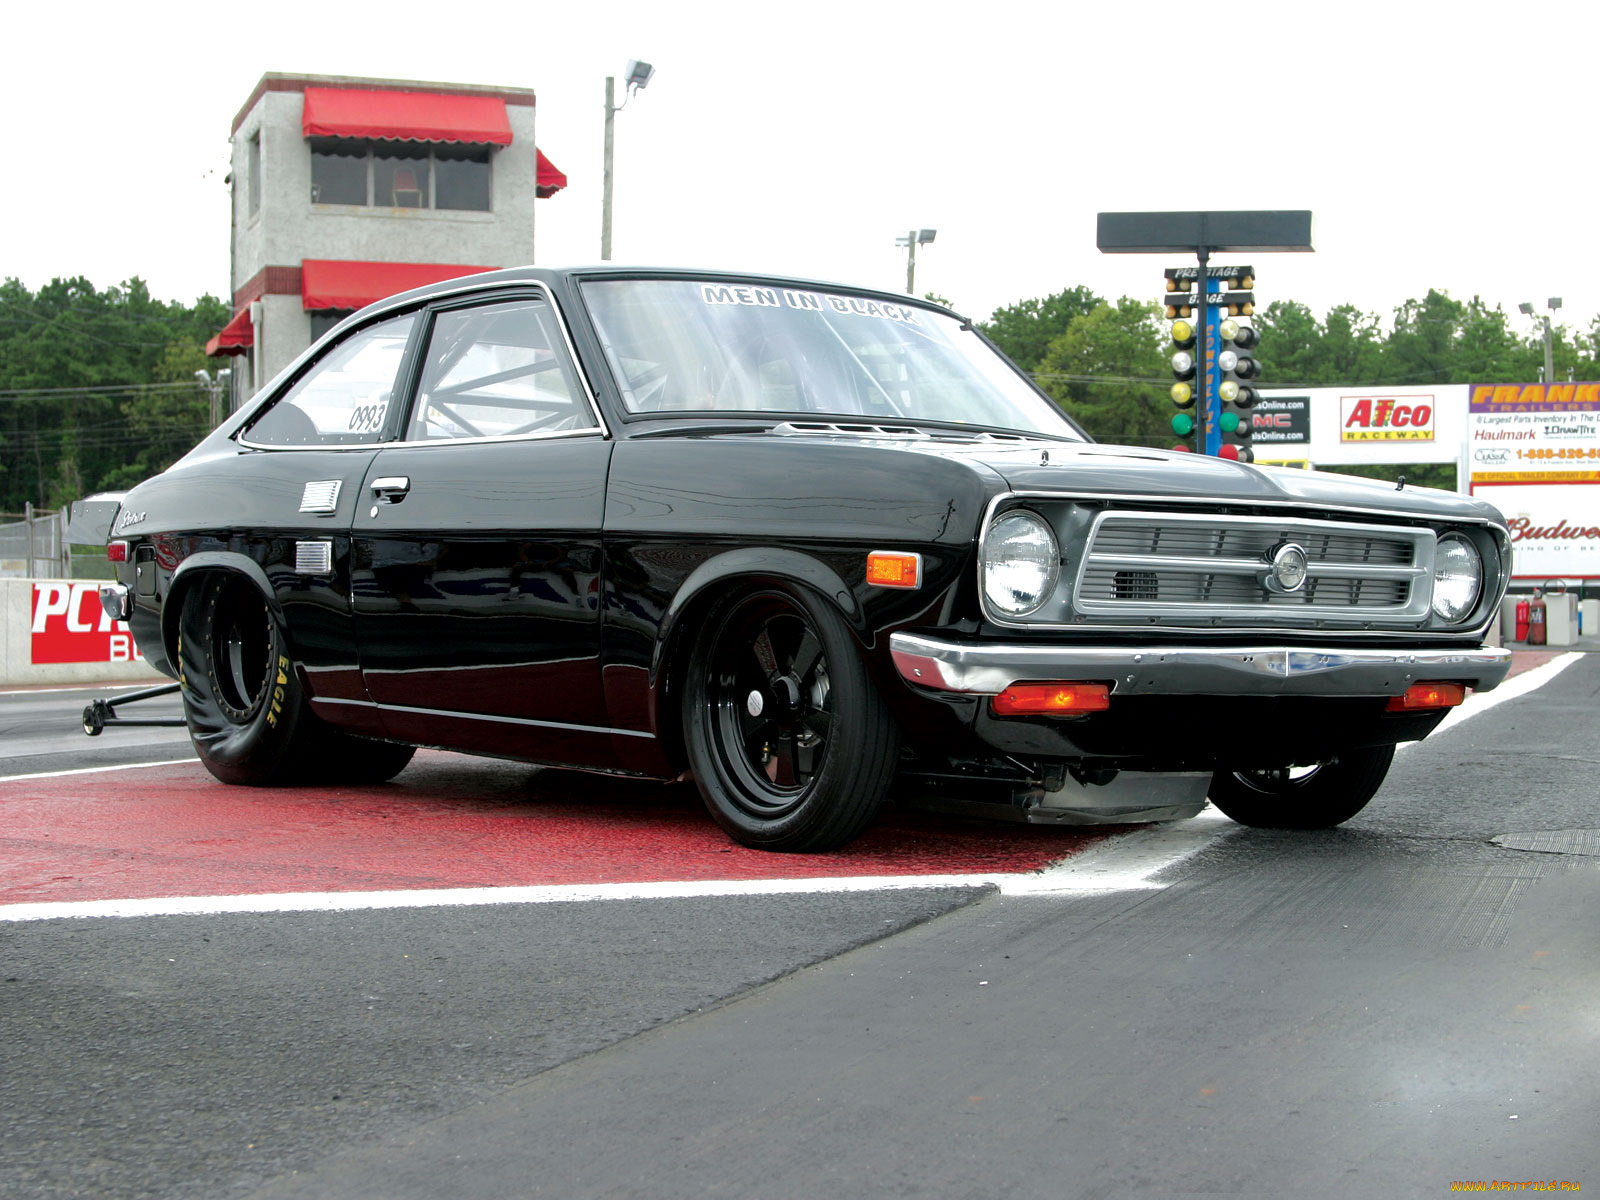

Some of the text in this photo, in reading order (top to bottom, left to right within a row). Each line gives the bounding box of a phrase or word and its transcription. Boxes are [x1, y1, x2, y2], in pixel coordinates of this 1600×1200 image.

[1175, 268, 1198, 279] PRE
[1188, 294, 1225, 304] SGE
[702, 286, 919, 324] MEN IN BLACK
[1254, 400, 1304, 409] sOnline.com
[1487, 404, 1594, 412] TRAILERS
[348, 404, 386, 431] 0993
[1252, 413, 1291, 427] MC
[1483, 416, 1512, 425] Largest
[1534, 414, 1567, 424] Inventory
[1347, 431, 1431, 439] RACEWAY
[1474, 429, 1536, 440] Haulmark
[1507, 517, 1600, 543] Budwe
[266, 654, 290, 729] EAGLE
